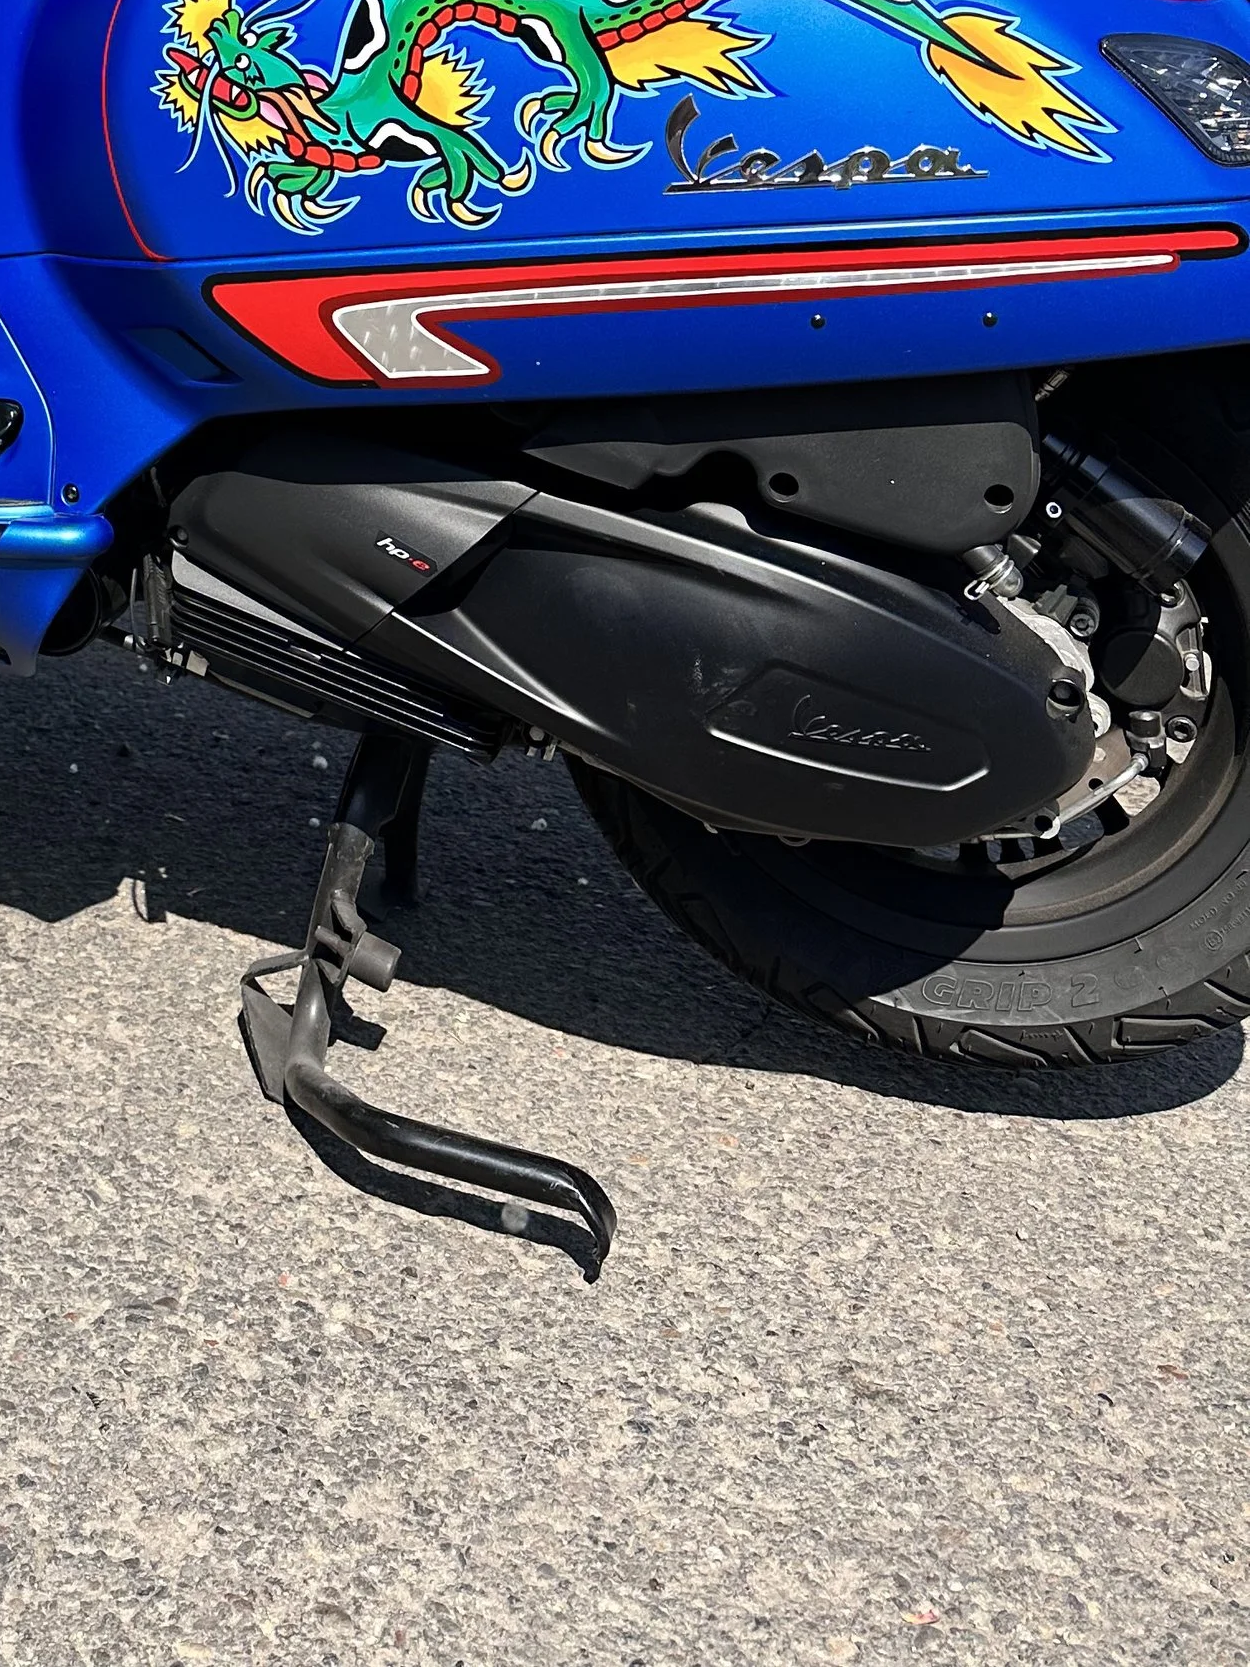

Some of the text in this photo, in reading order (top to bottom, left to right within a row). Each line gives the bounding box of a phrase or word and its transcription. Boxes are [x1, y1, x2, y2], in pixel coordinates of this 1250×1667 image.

[662, 92, 990, 196] Vespa
[788, 693, 932, 752] Vespa
[921, 971, 1100, 1012] GRIP 2
